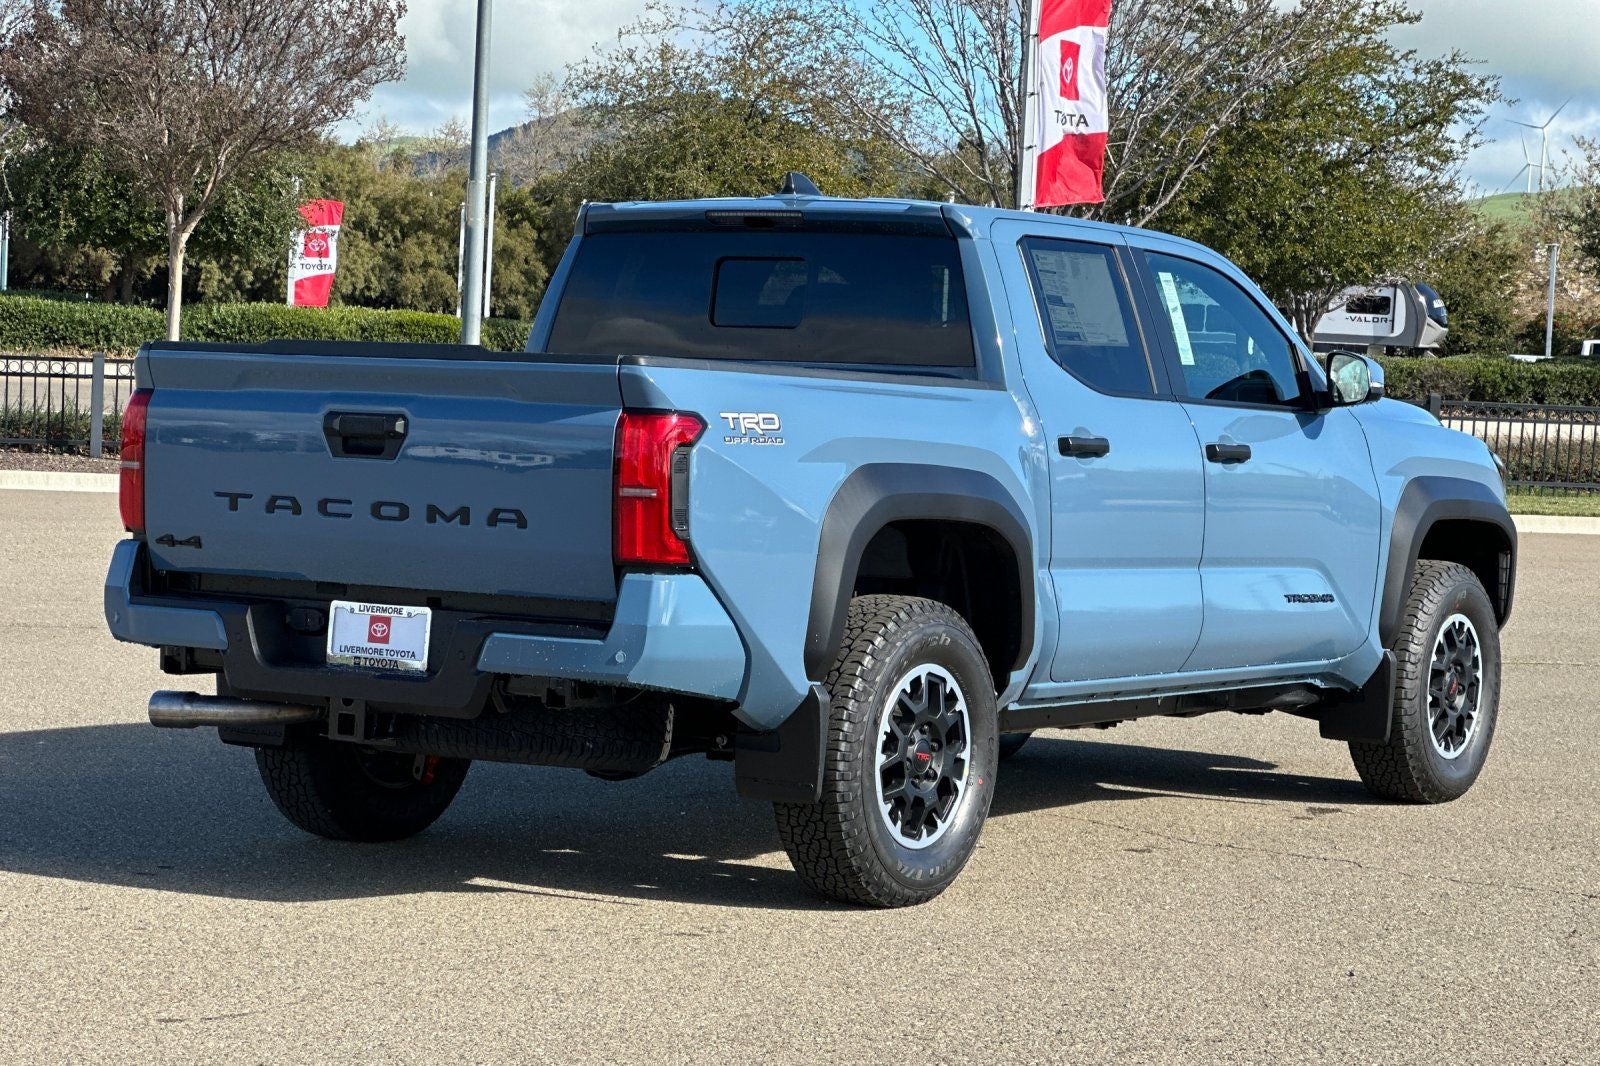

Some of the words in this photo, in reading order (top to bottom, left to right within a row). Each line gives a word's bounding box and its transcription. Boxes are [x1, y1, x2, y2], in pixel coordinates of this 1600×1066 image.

[719, 412, 781, 436] TRD
[724, 436, 748, 444] OFF
[750, 436, 784, 445] ROAD
[214, 491, 528, 530] TACOMA
[359, 604, 404, 615] LIVERMORE
[339, 645, 384, 656] LIVERMORE
[385, 649, 416, 659] TOYOTA
[363, 657, 399, 669] TOYOTA
